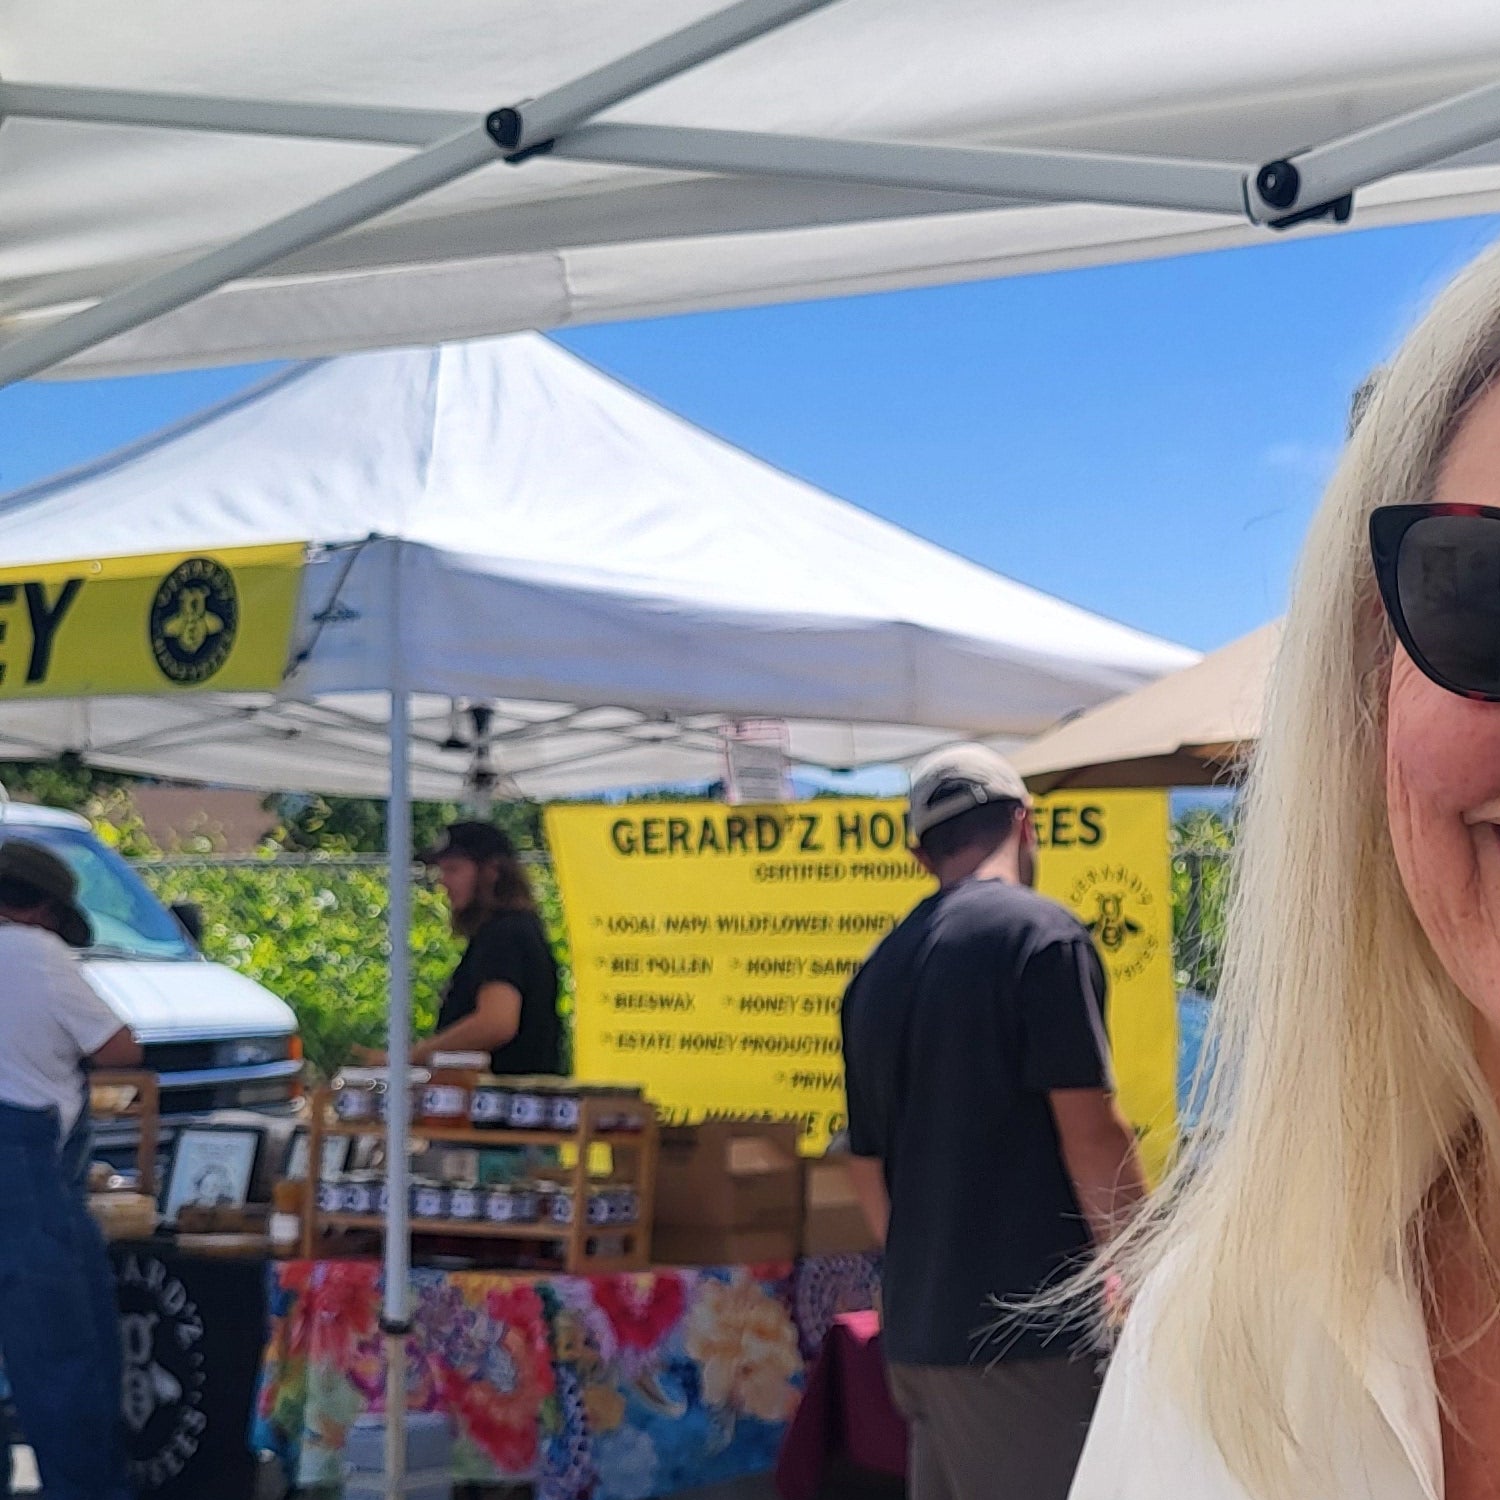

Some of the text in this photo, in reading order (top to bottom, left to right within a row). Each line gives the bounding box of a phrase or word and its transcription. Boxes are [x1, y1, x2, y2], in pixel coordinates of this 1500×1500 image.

[611, 813, 824, 856] GERARD'Z
[756, 861, 929, 882] CERTIFIED PRODUC
[608, 915, 656, 935] LOCAL
[664, 914, 708, 935] NAPA
[718, 913, 831, 936] WILDFLOWER
[610, 957, 714, 975] BEE POLLEN
[746, 957, 865, 976] HONEY SAMP
[614, 992, 696, 1010] BEESWAX
[740, 994, 799, 1013] HONEY
[618, 1031, 843, 1054] ESTATE HONEY PRODUCTIO
[791, 1070, 844, 1090] PRIVA
